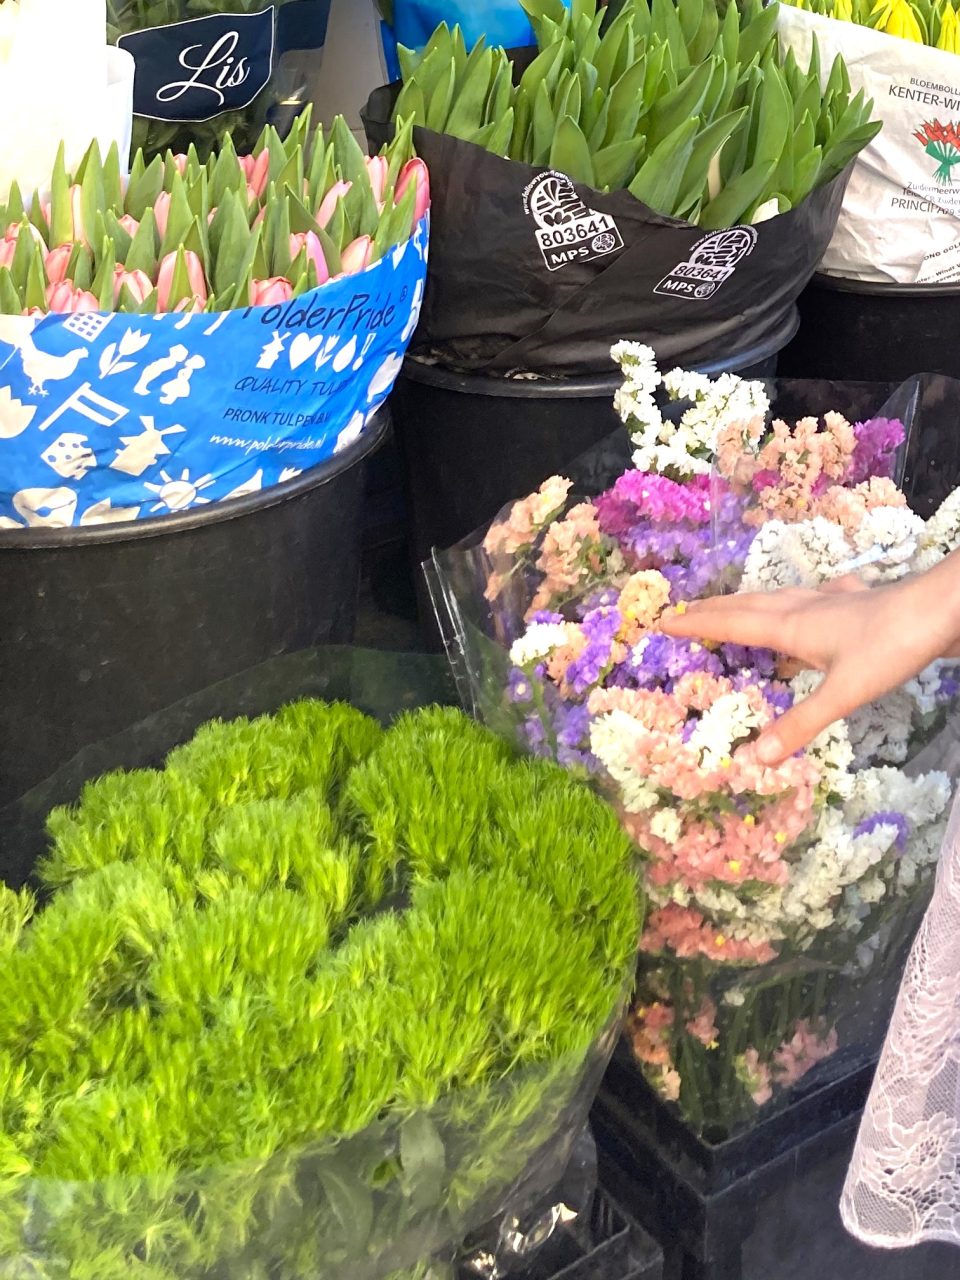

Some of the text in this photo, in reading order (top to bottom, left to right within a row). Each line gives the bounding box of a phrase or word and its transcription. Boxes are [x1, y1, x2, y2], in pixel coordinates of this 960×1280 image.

[156, 31, 250, 106] Lis
[540, 215, 610, 247] 803641
[551, 246, 590, 264] MPS
[674, 265, 730, 280] 803641
[663, 280, 695, 293] MPS
[234, 376, 306, 396] QUALITY
[223, 407, 272, 424] PRONK
